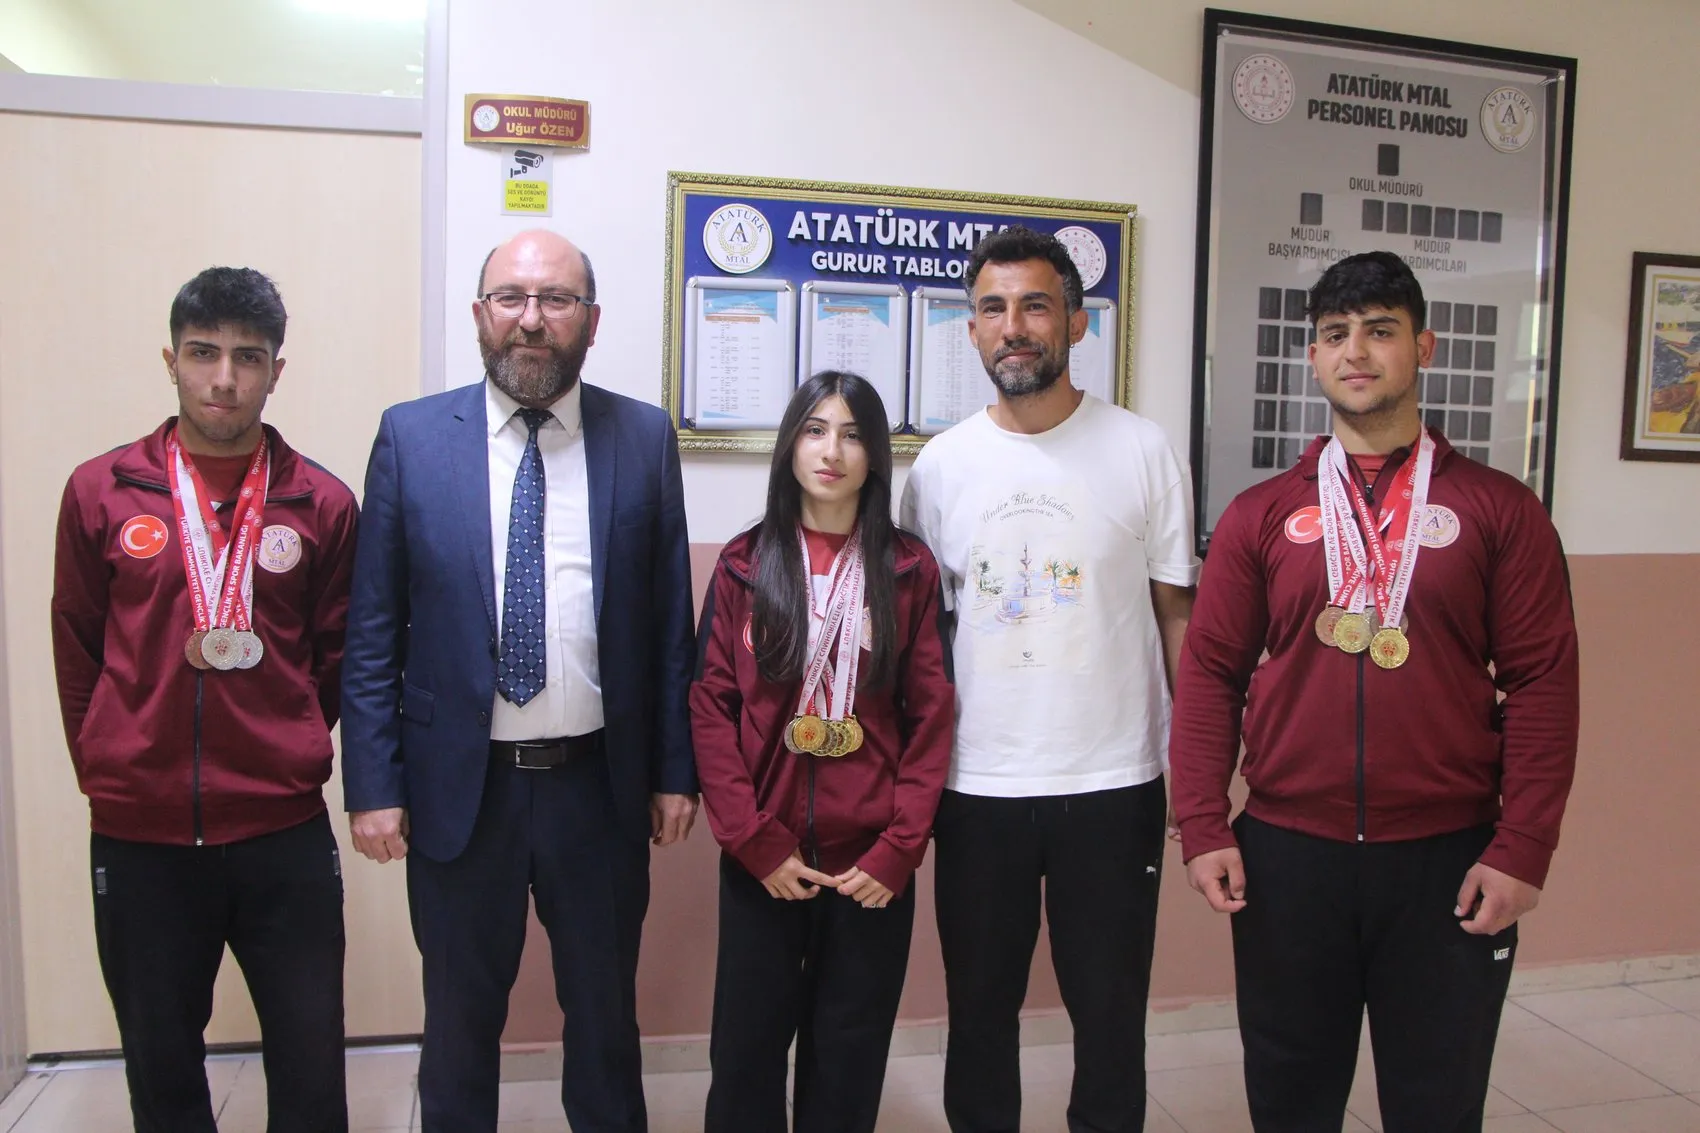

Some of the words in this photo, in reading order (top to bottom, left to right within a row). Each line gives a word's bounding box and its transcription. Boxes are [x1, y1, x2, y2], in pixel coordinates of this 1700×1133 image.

[1327, 73, 1404, 102] ATATÜRK
[1407, 83, 1452, 109] MTAL
[503, 106, 532, 118] OKUL
[534, 106, 577, 121] MÜDÜRÜ
[506, 122, 536, 136] Uğur
[540, 121, 574, 137] ÖZEN
[1307, 99, 1396, 130] PERSONEL
[1399, 110, 1468, 138] PANOSU
[1349, 177, 1376, 193] OKUL
[1379, 178, 1424, 197] MÜDÜRÜ
[787, 208, 940, 249] ATATÜRK
[947, 221, 1009, 251] MT
[812, 251, 886, 275] GURUR
[982, 502, 1008, 523] Under
[1011, 491, 1035, 506] Blue
[1356, 496, 1378, 543] CUMHURİYETİ
[235, 524, 249, 565] BAKANLIĞI
[179, 515, 191, 544] TÜRKİYE
[185, 544, 201, 593] CUMHURİYETİ
[193, 592, 206, 623] GENÇLİK
[230, 565, 241, 585] SPOR
[228, 583, 236, 595] VE
[220, 593, 234, 628] GENÇLİK
